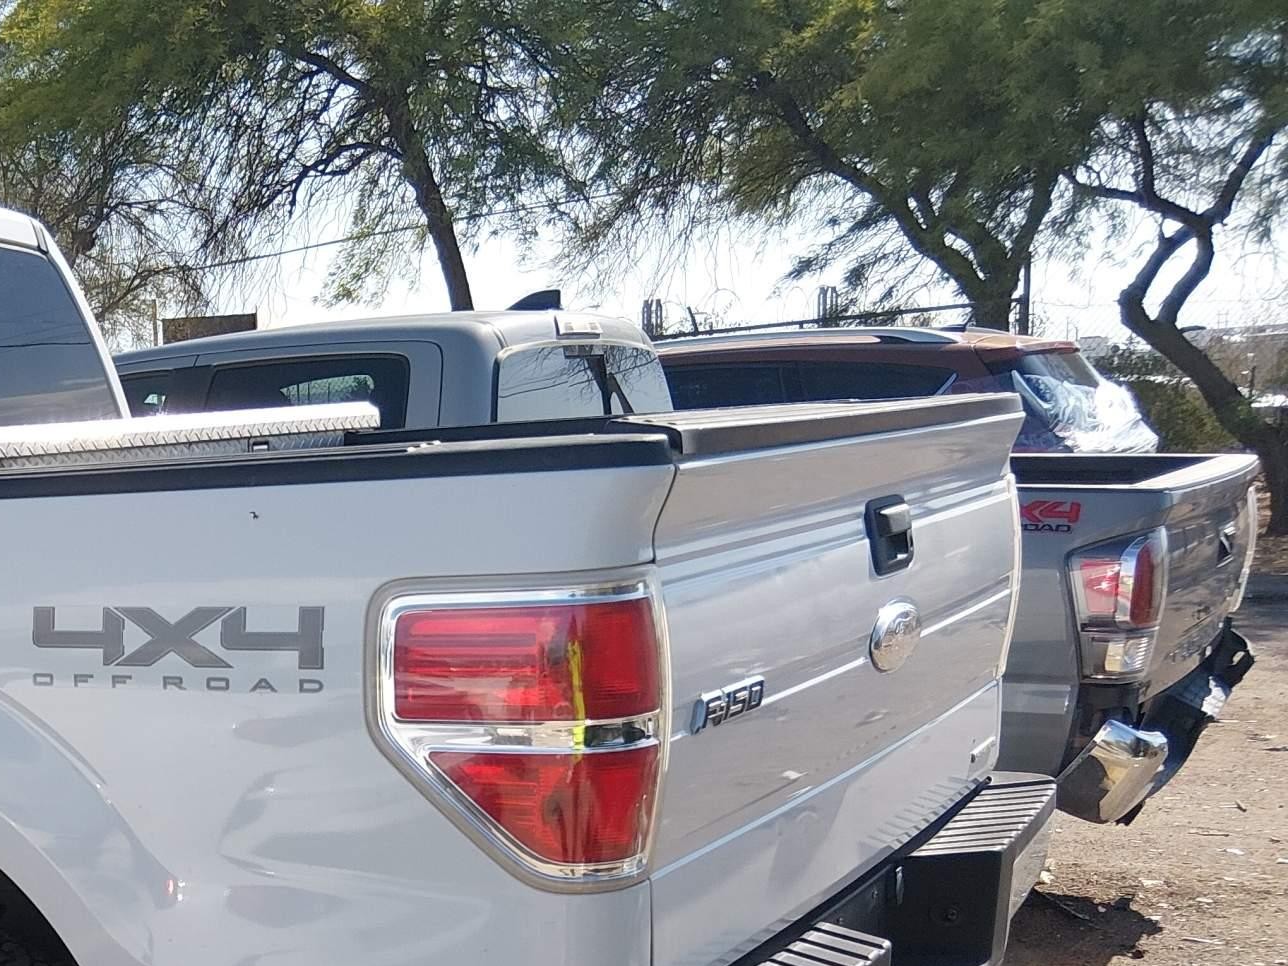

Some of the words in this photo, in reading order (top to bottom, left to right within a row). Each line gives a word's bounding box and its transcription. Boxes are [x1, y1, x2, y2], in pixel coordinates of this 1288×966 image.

[1019, 500, 1081, 524] X4
[1021, 523, 1072, 534] OAD
[32, 606, 325, 670] 4X4
